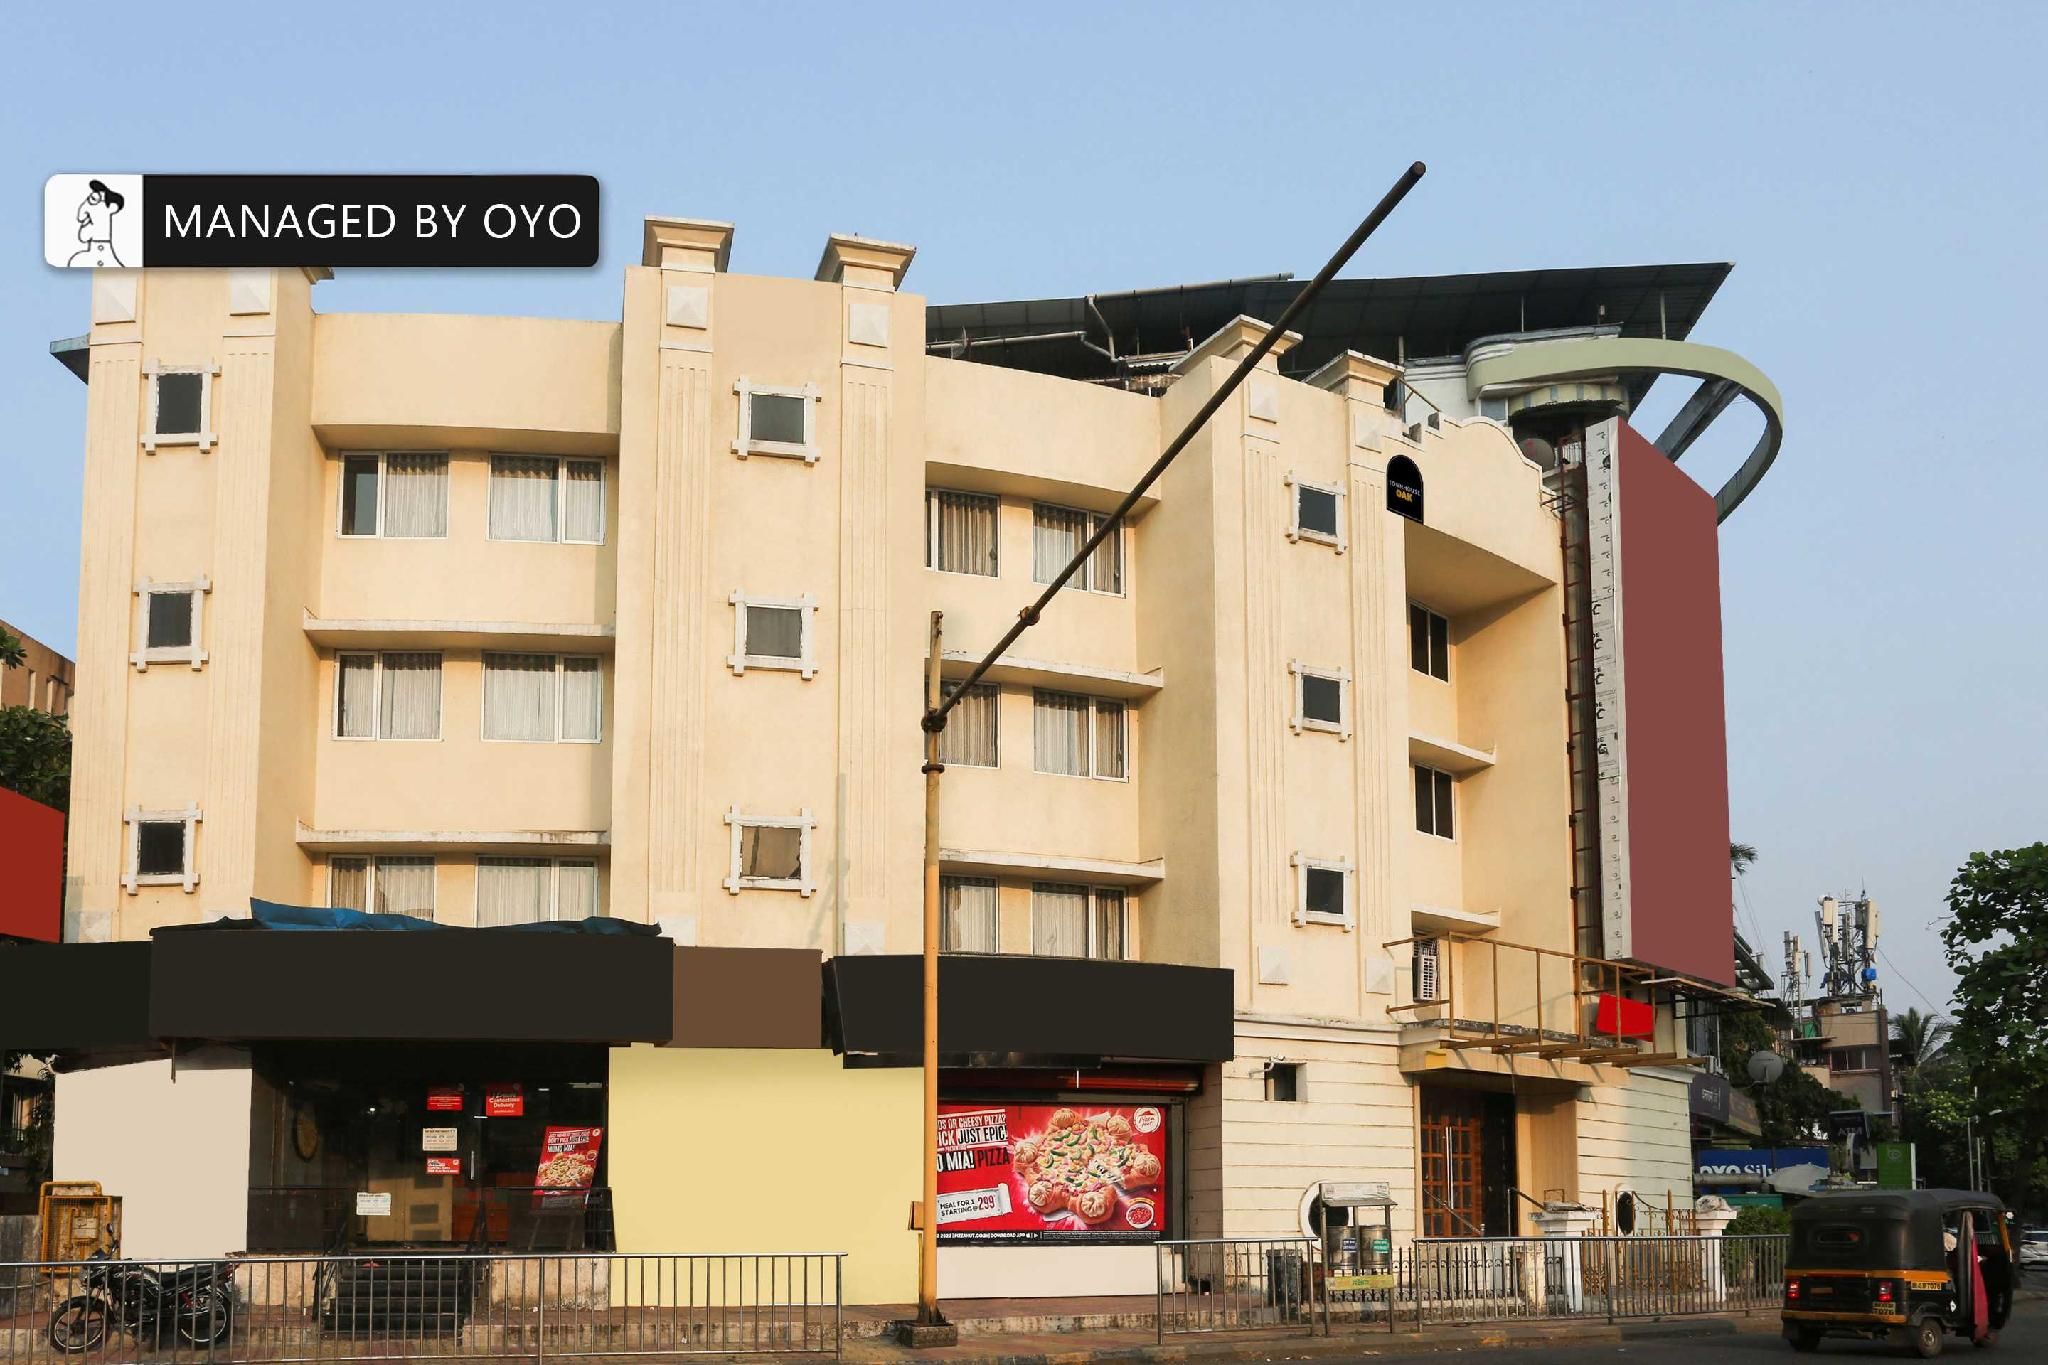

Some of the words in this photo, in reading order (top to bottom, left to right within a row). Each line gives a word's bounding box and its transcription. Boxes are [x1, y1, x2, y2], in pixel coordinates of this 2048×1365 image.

[1396, 488, 1413, 502] OAK
[948, 1118, 957, 1129] OR
[958, 1115, 983, 1128] CHEESY
[984, 1113, 1006, 1125] PIZZA?
[938, 1130, 956, 1147] ICK
[958, 1128, 981, 1144] JUST
[984, 1125, 1008, 1142] EPIC!
[1838, 1127, 1863, 1136] ATM
[945, 1151, 975, 1171] MIA!
[977, 1147, 1010, 1168] PIZZA
[941, 1206, 972, 1216] STARTING
